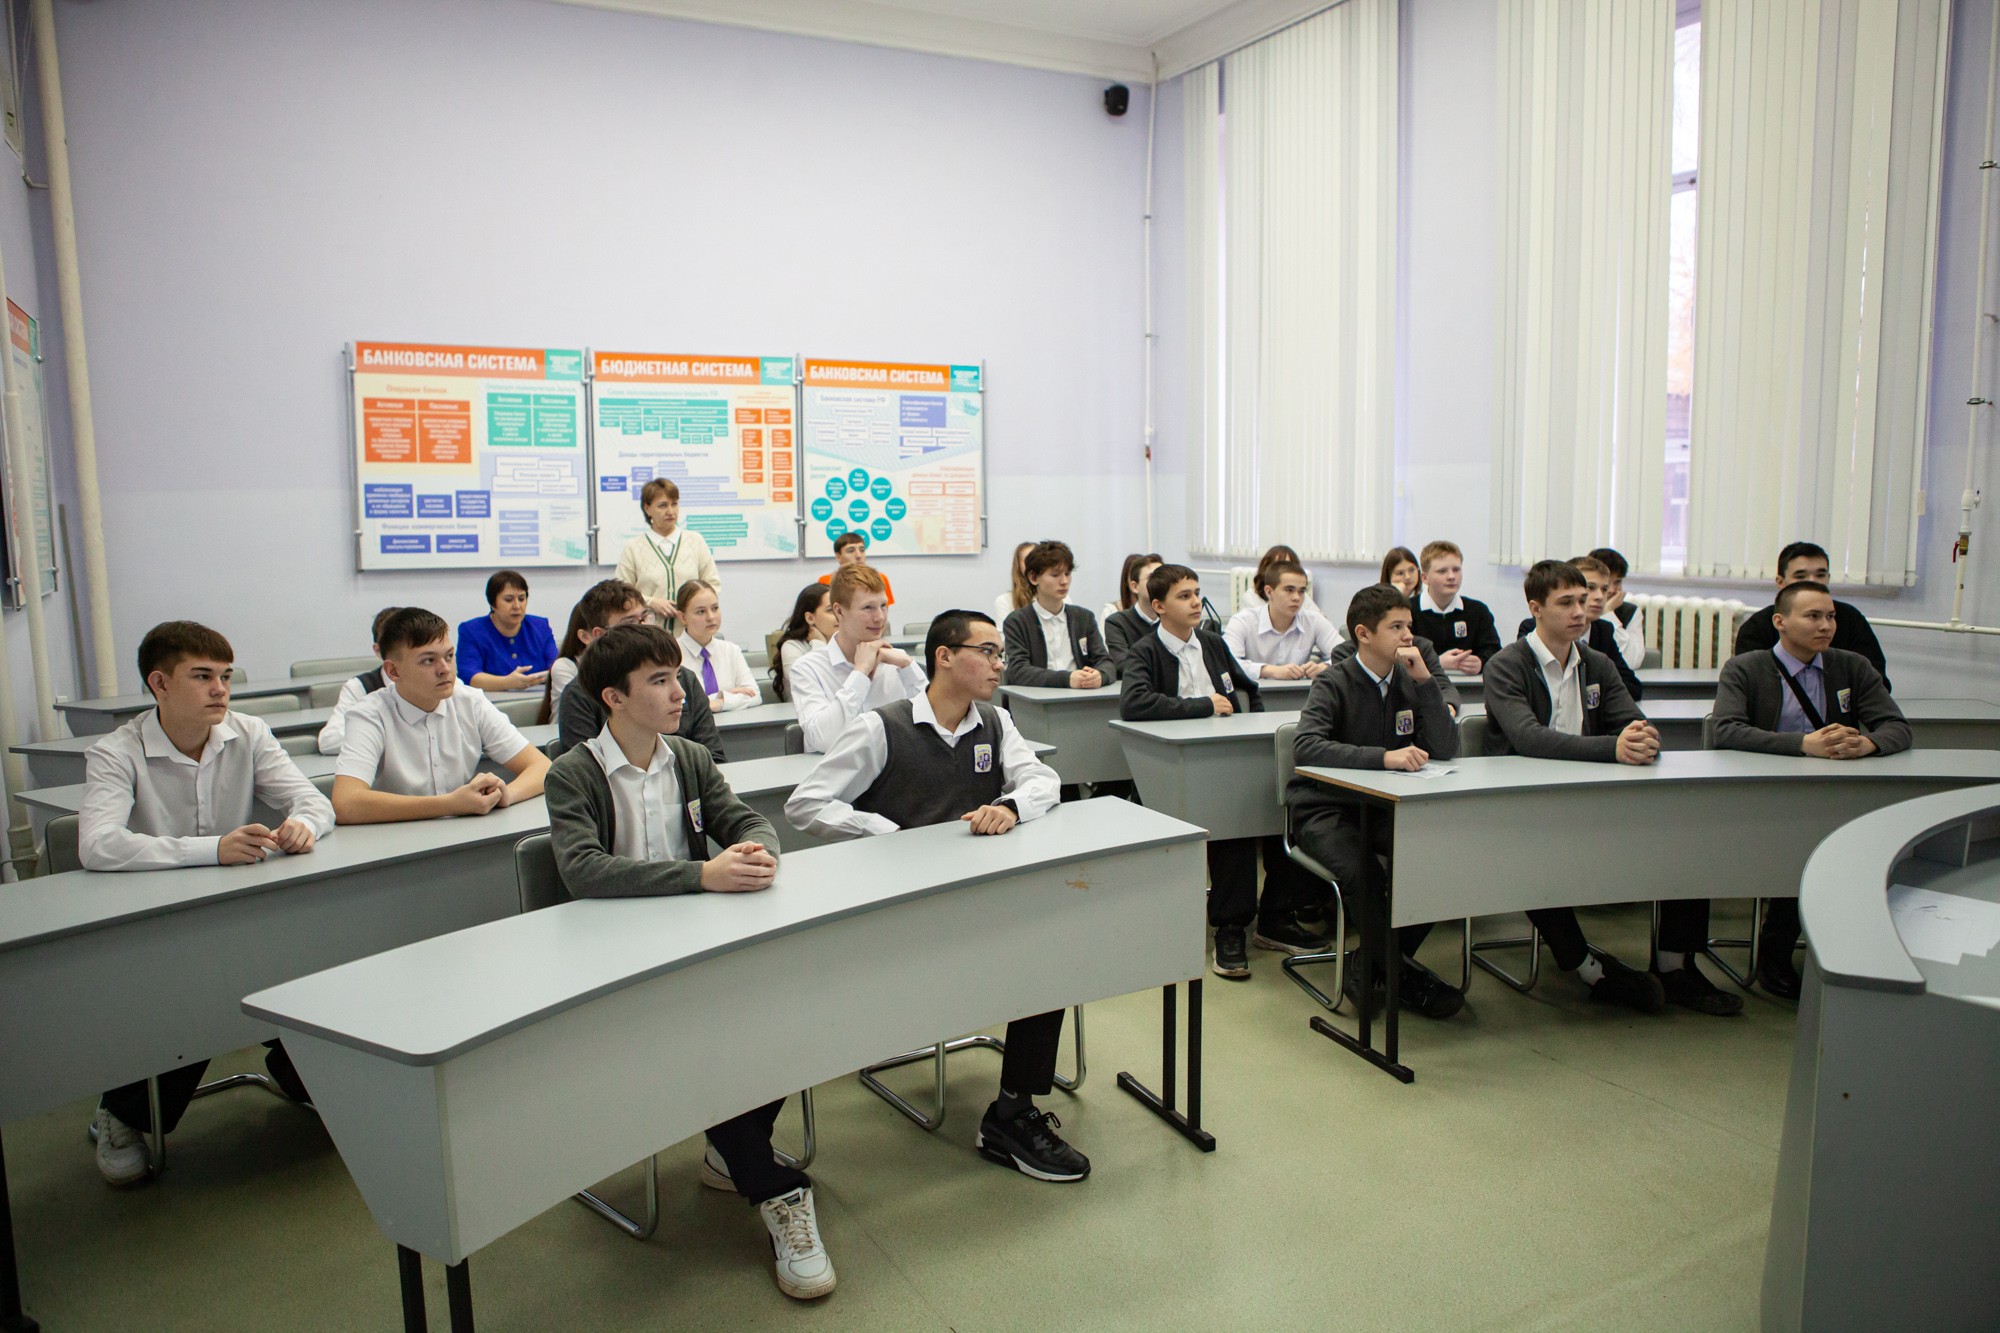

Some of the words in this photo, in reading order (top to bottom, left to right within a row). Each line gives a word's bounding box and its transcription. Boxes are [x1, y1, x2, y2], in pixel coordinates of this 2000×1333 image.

[363, 349, 464, 369] БАНКОВСКАЯ
[467, 354, 538, 372] СИСТЕМА
[601, 359, 688, 377] БЮДЖЕТНАЯ
[691, 362, 754, 378] СИСТЕМА
[810, 366, 888, 382] БАНКОВСКАЯ
[890, 369, 945, 384] СИСТЕМА
